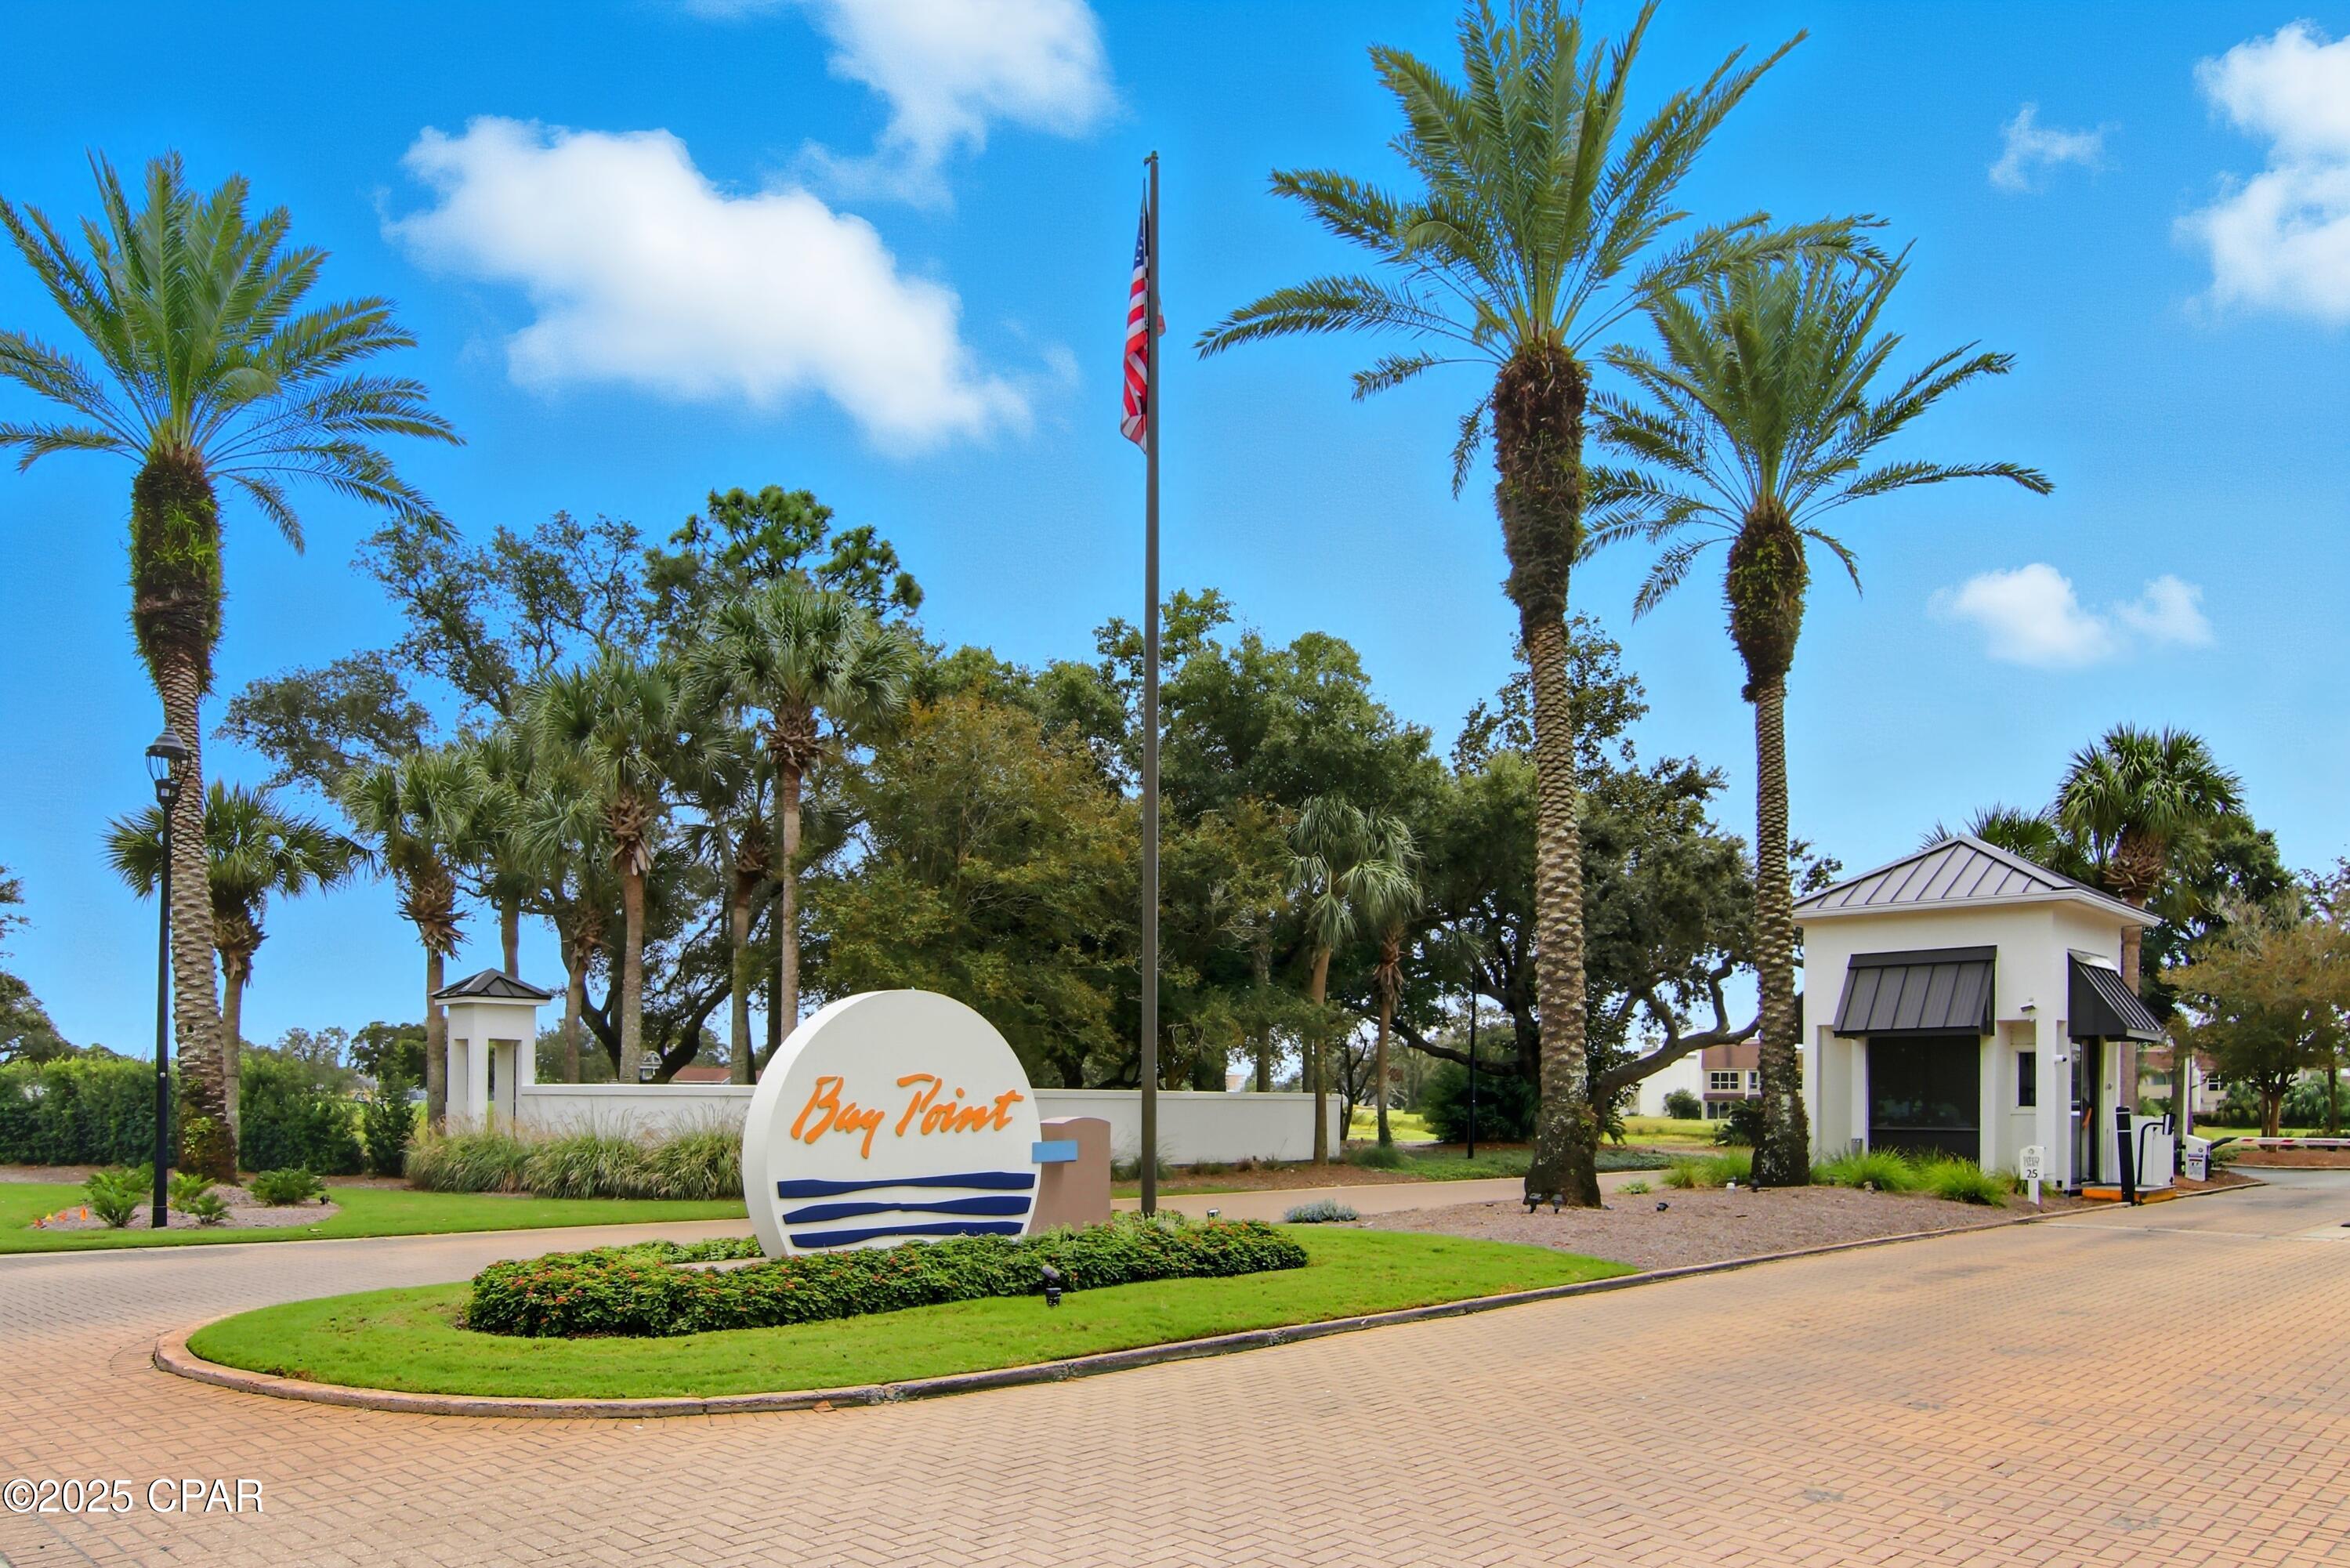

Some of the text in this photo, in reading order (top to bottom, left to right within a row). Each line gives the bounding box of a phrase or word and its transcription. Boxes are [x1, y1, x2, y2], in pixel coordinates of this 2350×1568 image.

[791, 1073, 1024, 1159] Bay Point
[2026, 1168, 2038, 1179] 25
